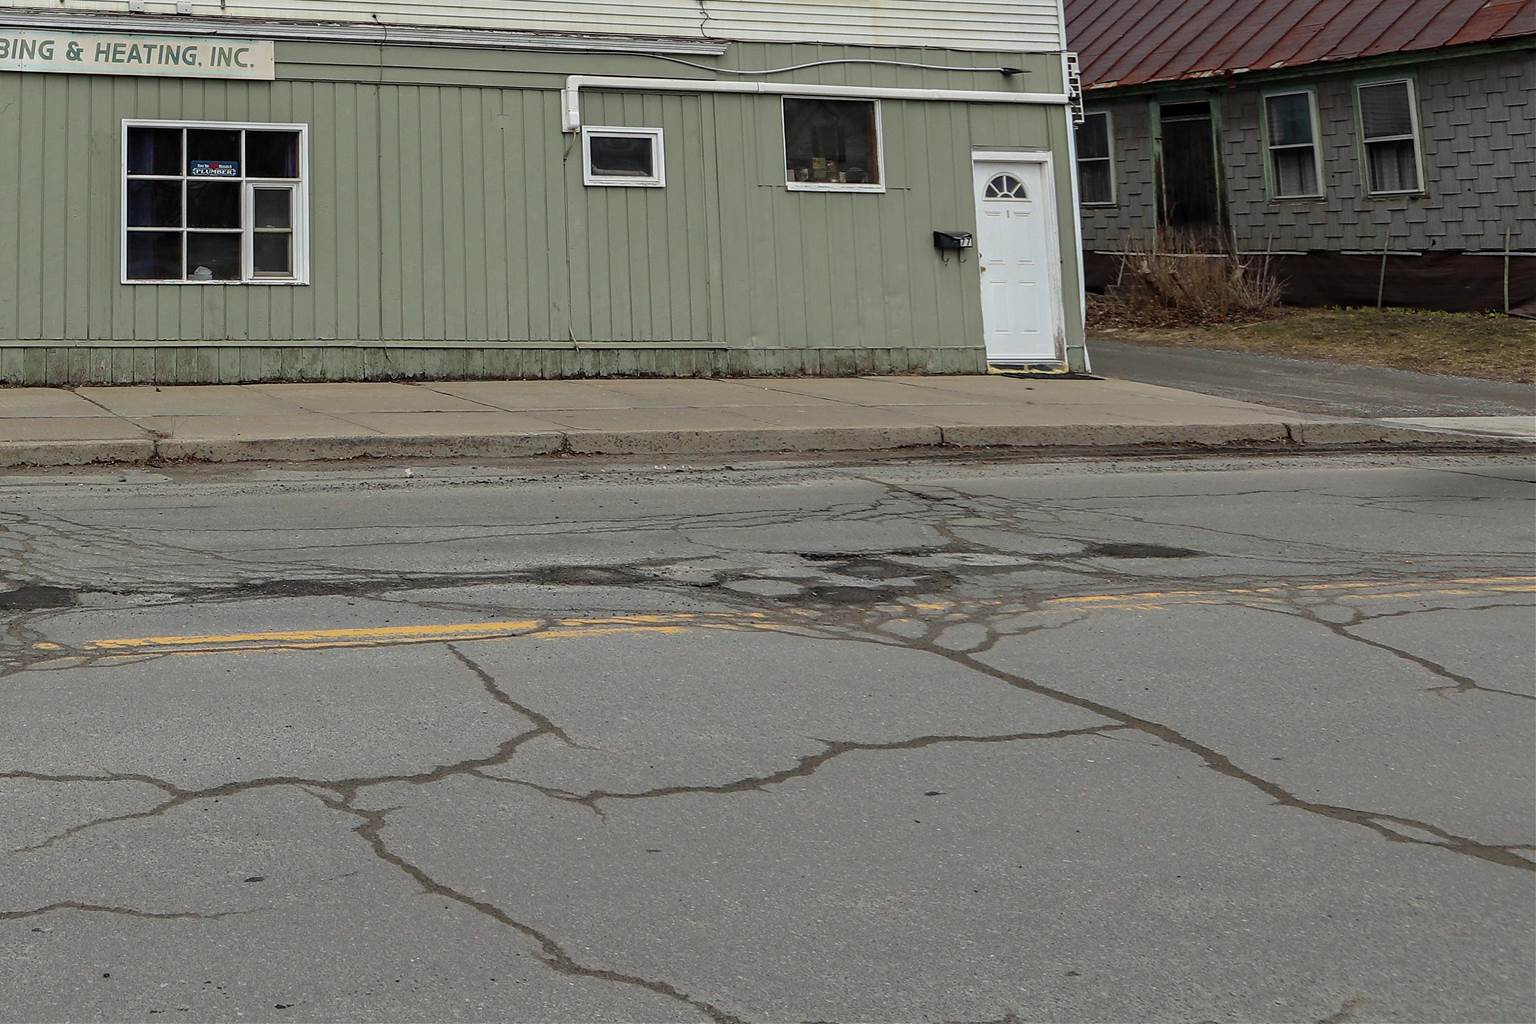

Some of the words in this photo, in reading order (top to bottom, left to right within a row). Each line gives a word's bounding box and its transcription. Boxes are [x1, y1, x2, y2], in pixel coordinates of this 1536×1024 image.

[65, 40, 84, 62] &
[94, 42, 202, 67] HEATING,
[210, 46, 255, 68] INC.
